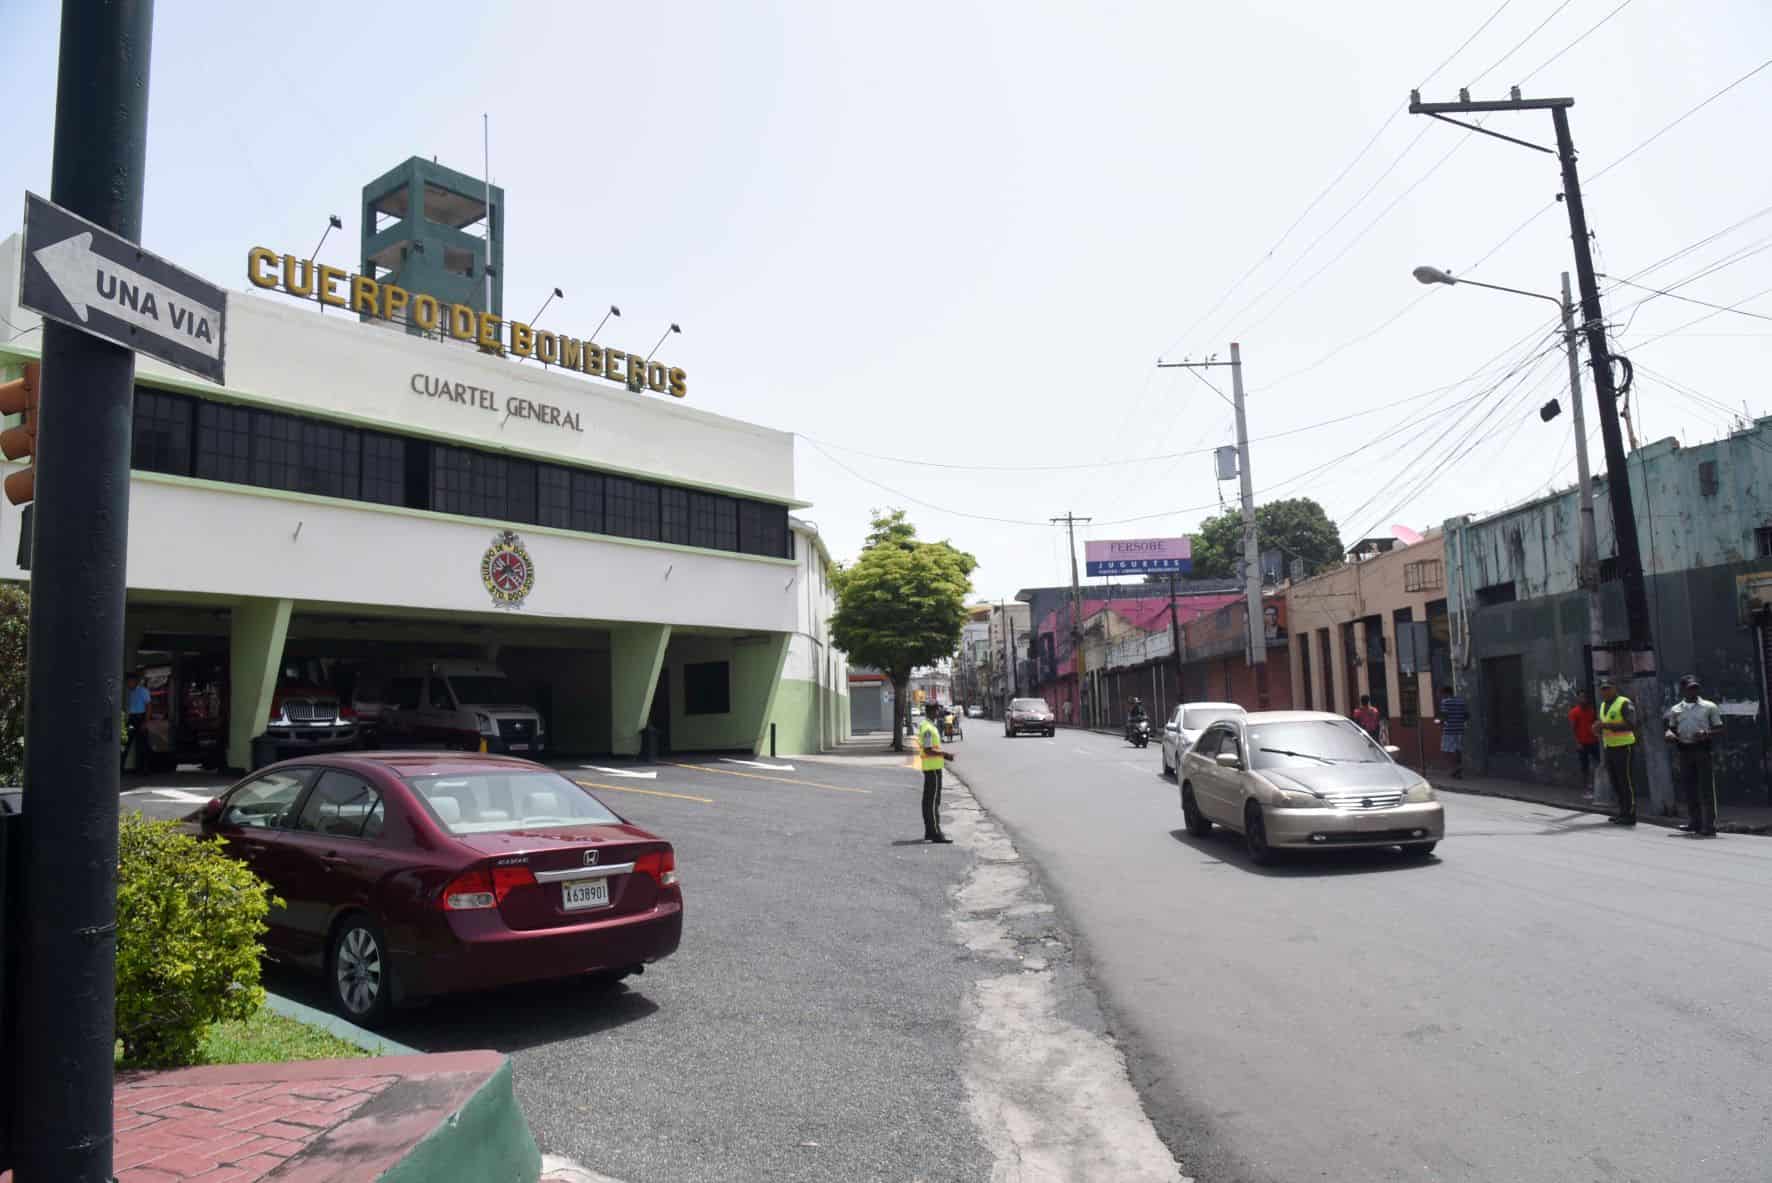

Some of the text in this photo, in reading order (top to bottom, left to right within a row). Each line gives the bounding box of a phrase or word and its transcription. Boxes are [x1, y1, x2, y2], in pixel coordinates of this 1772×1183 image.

[97, 269, 212, 344] UNA VIA
[248, 246, 687, 398] CUERPO DE BOMBEROS
[411, 374, 584, 432] CUARTEL GENERAL
[1098, 559, 1180, 568] JUGUETES
[566, 885, 608, 903] A638901
